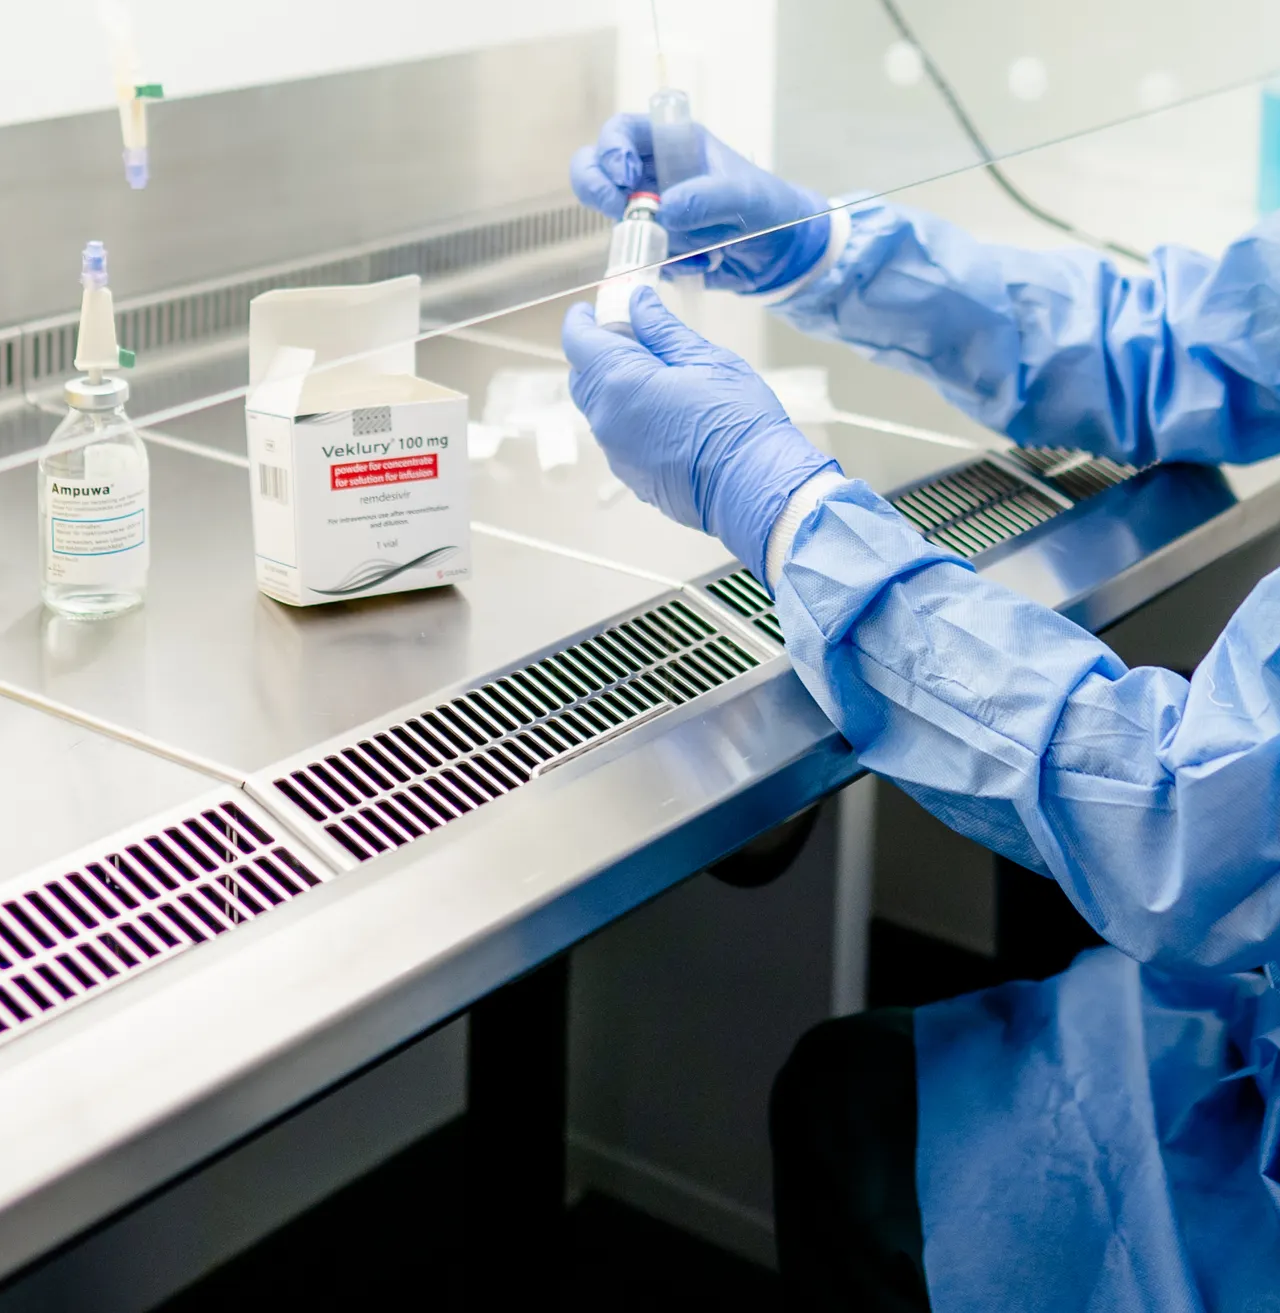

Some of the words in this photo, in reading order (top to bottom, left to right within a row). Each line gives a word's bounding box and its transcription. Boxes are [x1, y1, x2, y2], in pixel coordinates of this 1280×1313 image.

[322, 441, 392, 458] Veklury
[399, 436, 423, 450] 100
[427, 435, 449, 449] mg
[334, 462, 368, 477] powder
[369, 460, 382, 471] for
[382, 456, 433, 470] concentrate
[335, 477, 349, 488] for
[349, 474, 384, 486] solution
[385, 471, 398, 481] for
[399, 468, 434, 480] infusion
[52, 482, 111, 498] Ampuwa
[359, 490, 411, 505] remdesivir
